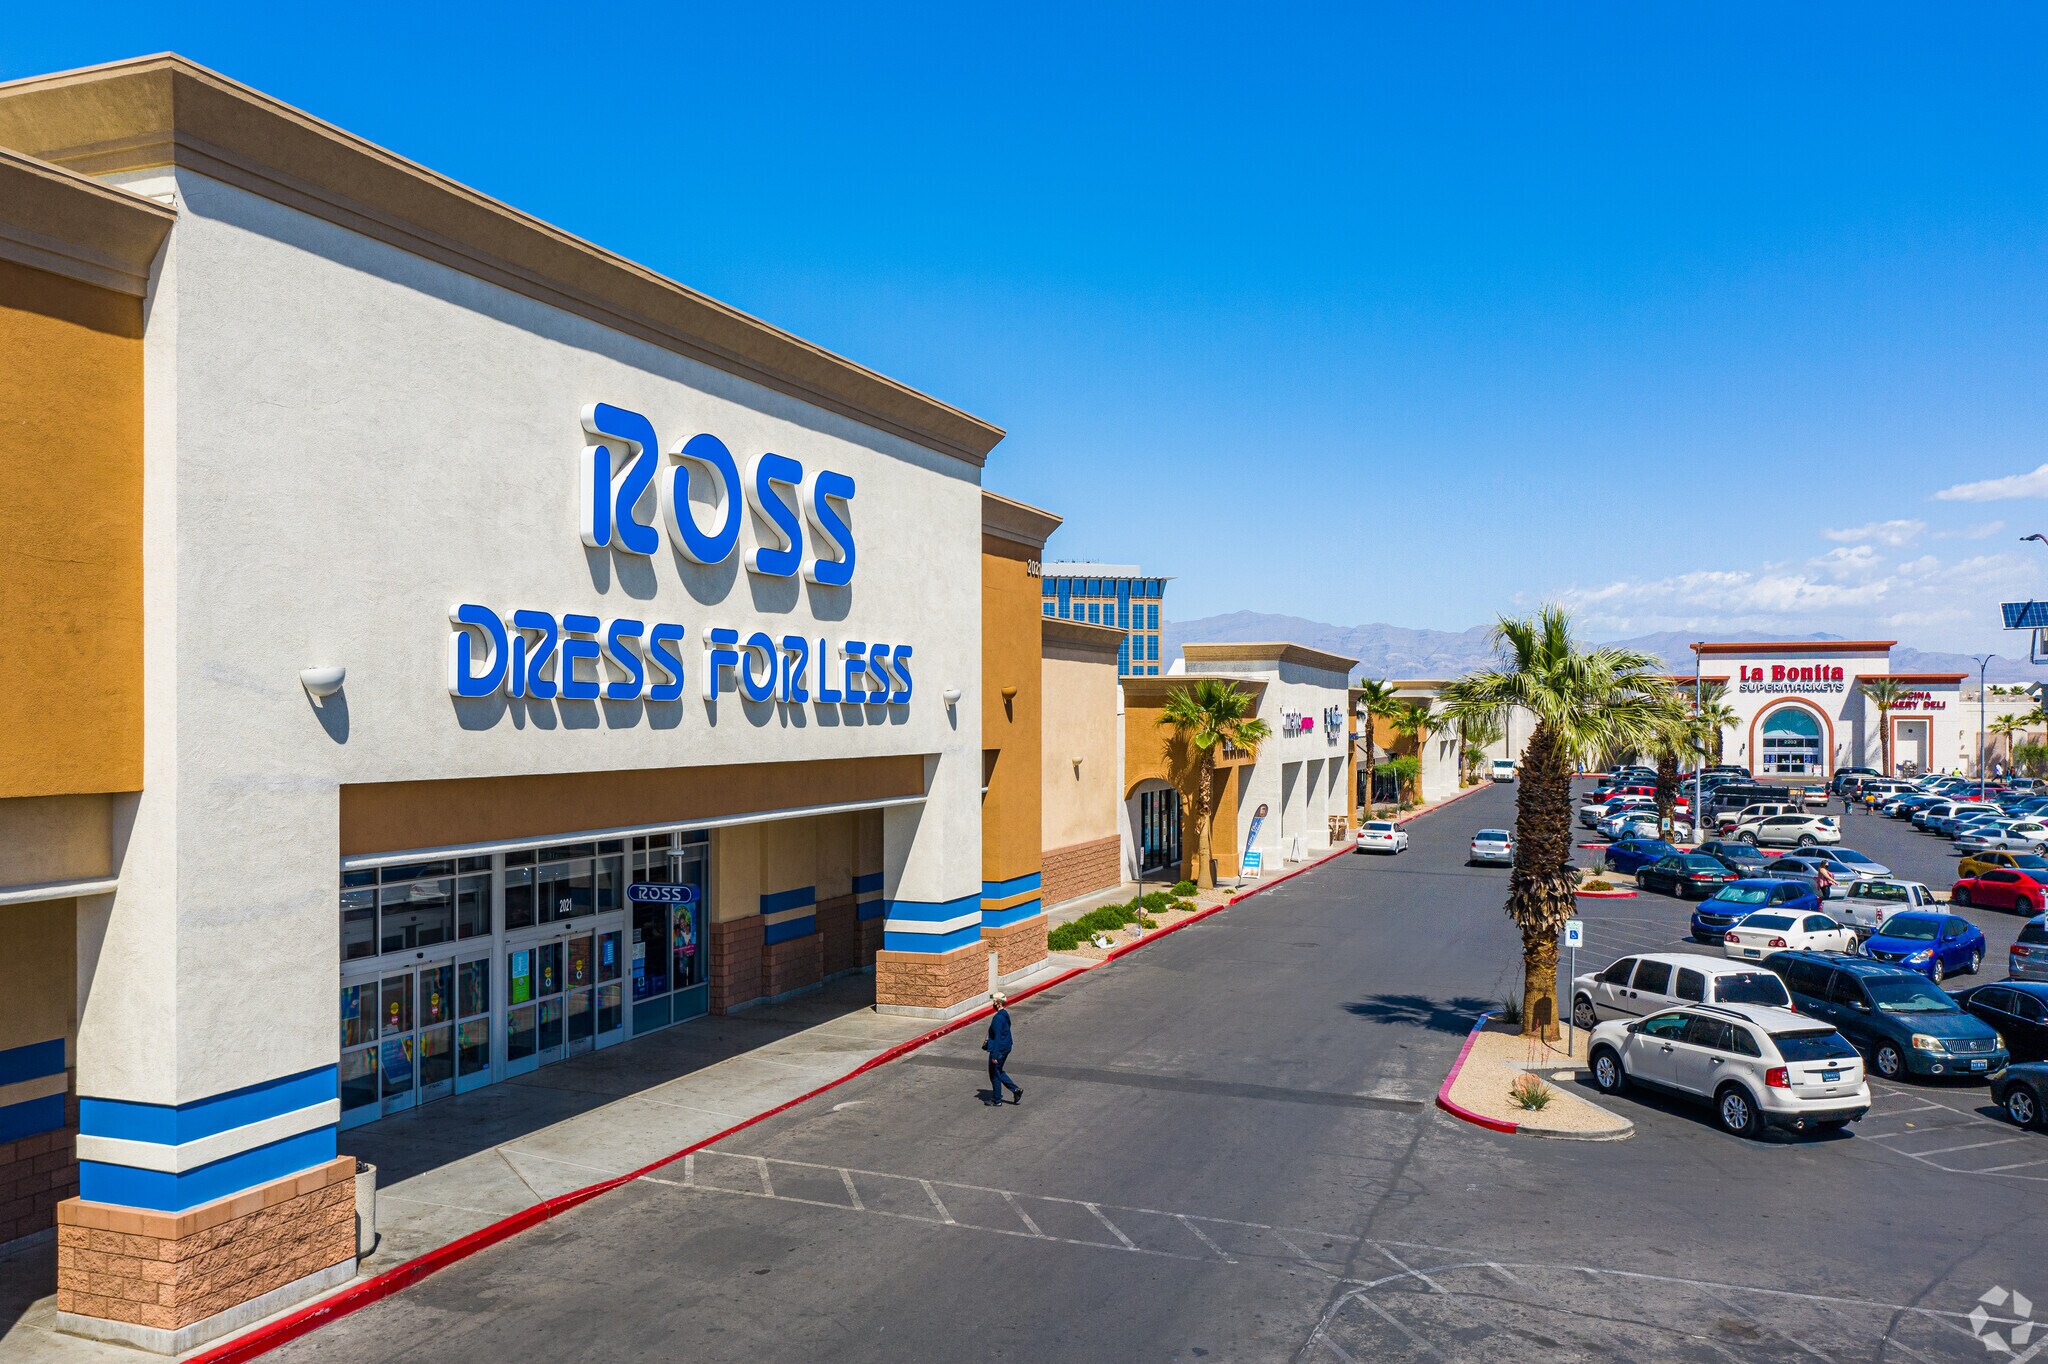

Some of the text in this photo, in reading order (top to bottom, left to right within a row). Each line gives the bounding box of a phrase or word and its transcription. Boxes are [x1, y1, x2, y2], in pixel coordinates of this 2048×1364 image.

[580, 402, 856, 587] ROSS
[448, 603, 914, 705] DRESS FOR LESS
[1740, 664, 1845, 682] La Bonita
[1740, 682, 1845, 693] SUPERMARKETS
[1923, 701, 1946, 710] DELI
[638, 886, 682, 901] ROSS
[559, 897, 572, 913] 2021
